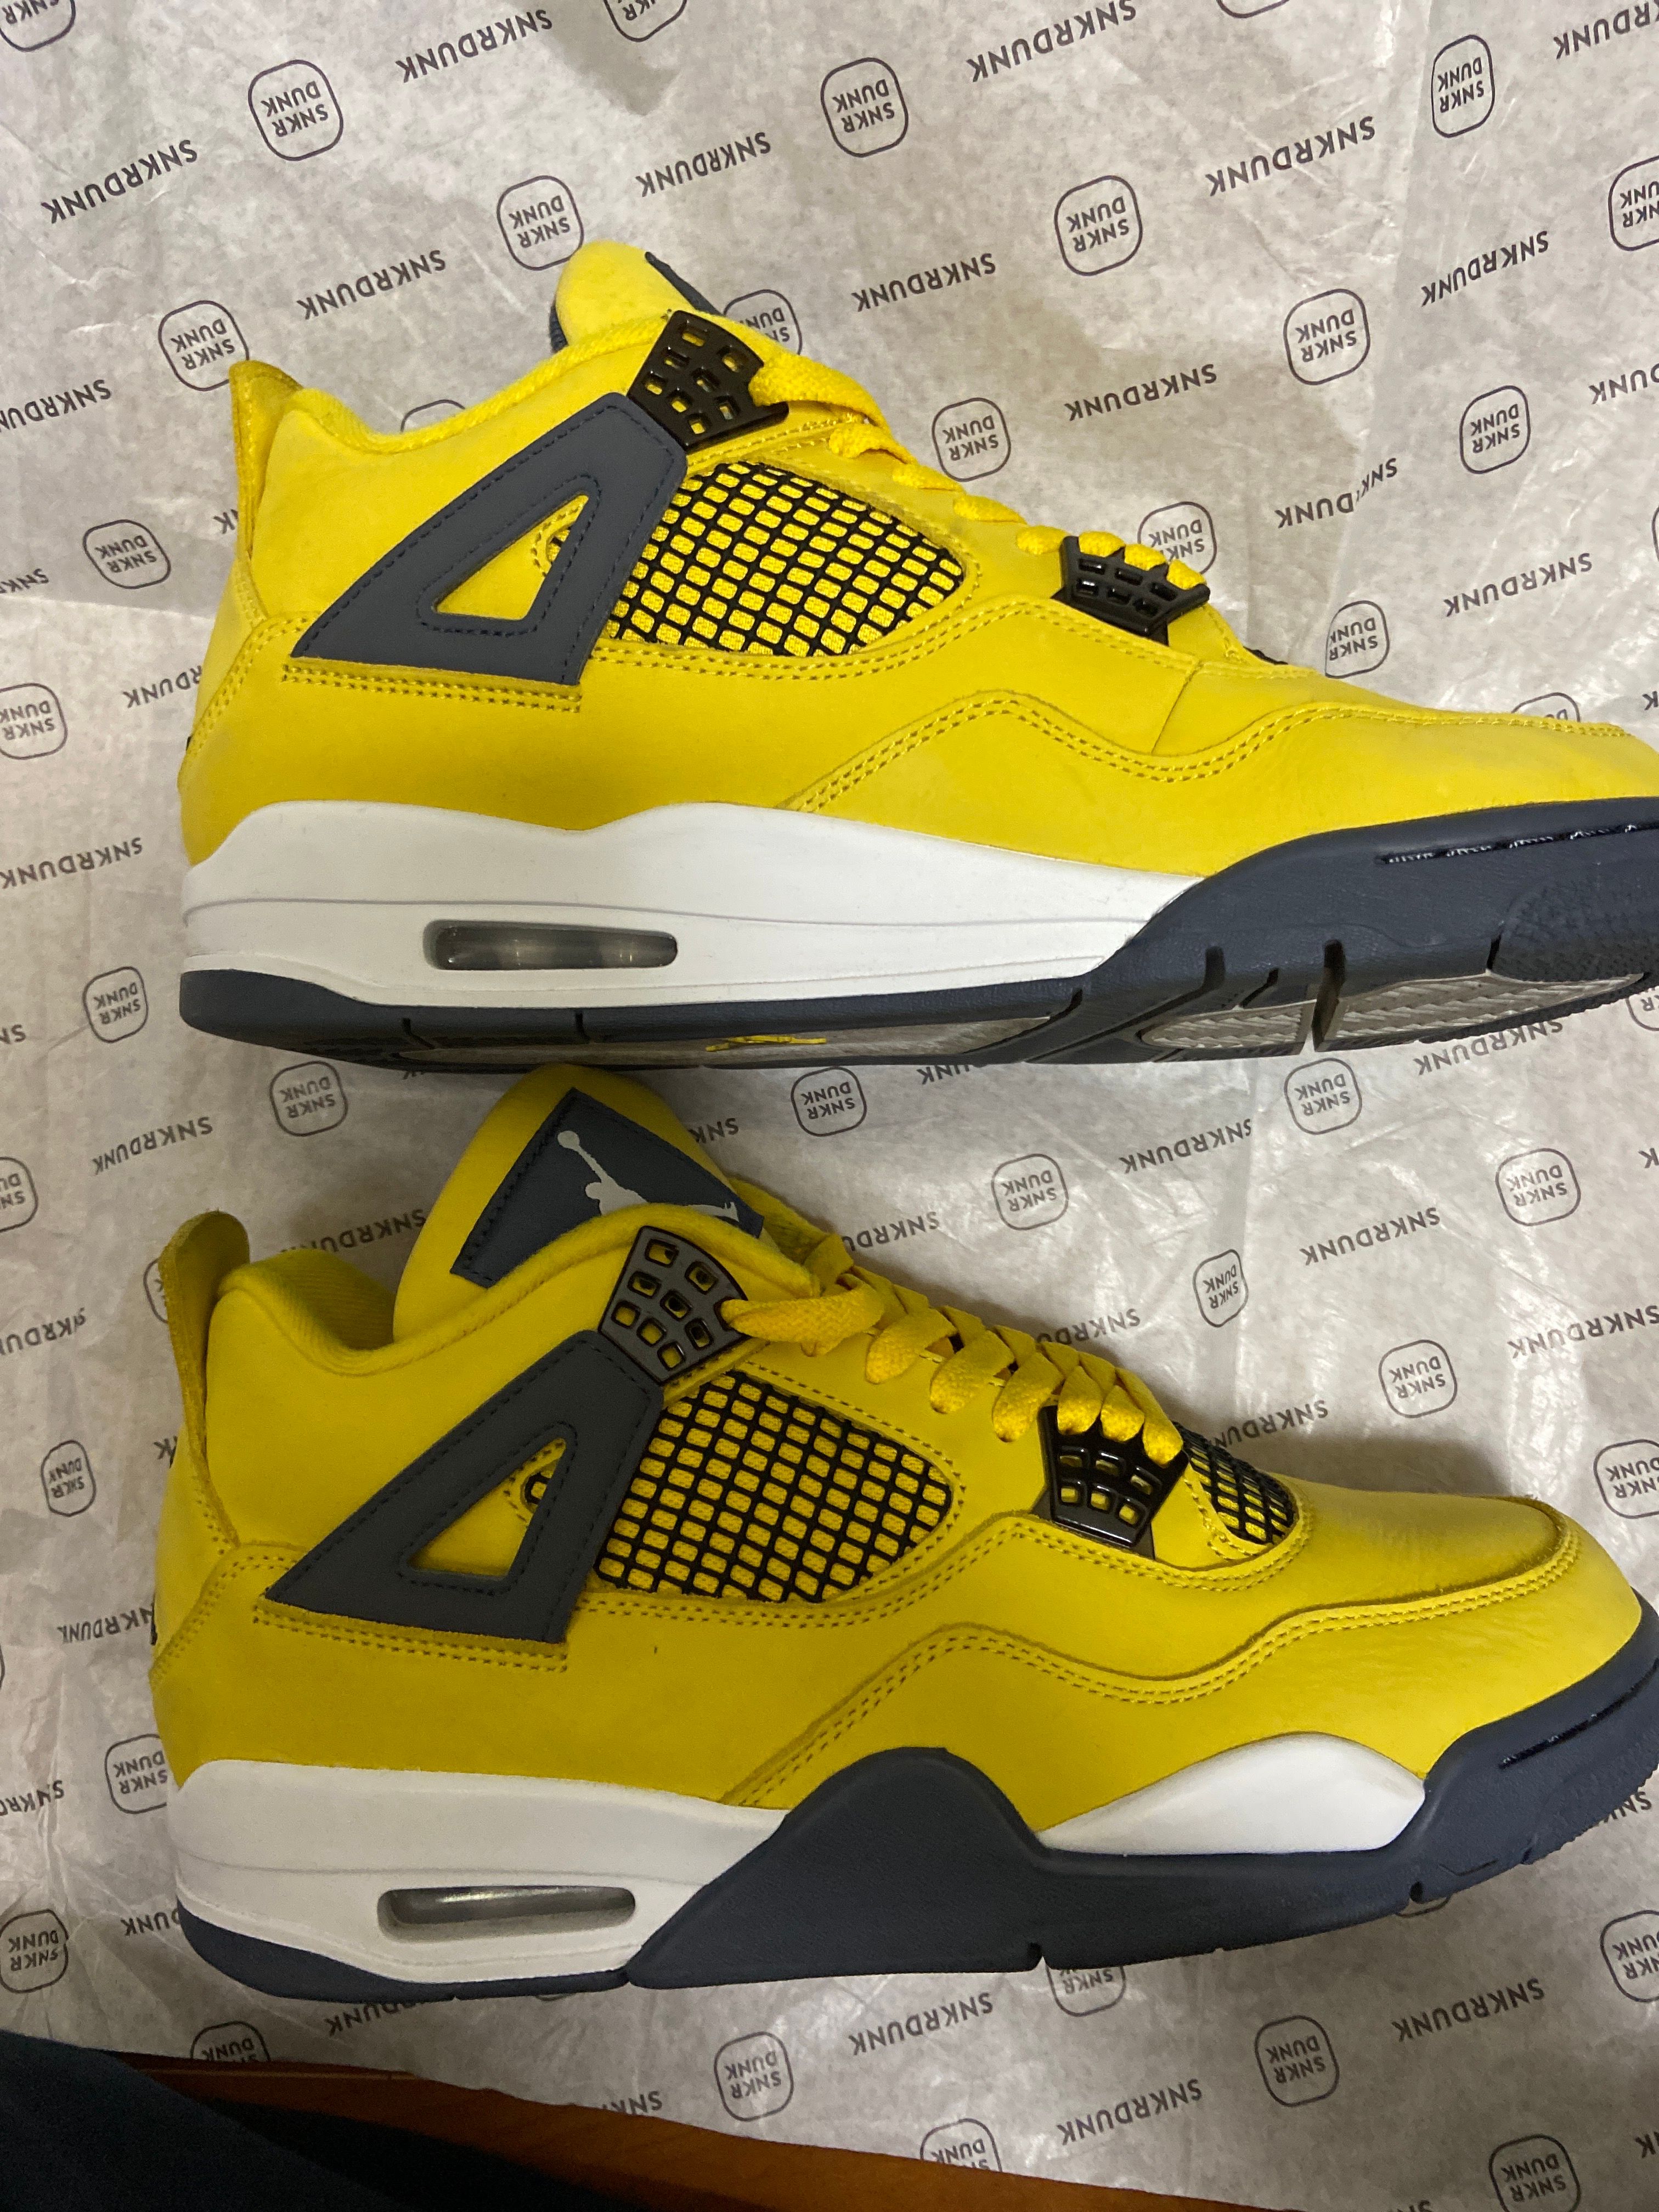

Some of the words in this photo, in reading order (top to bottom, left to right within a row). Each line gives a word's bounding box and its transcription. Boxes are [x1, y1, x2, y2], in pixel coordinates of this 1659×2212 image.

[396, 9, 552, 82] SNKRDUNK
[966, 0, 1136, 82] SNKRDUNK
[1438, 57, 1482, 92] DUNK
[261, 81, 320, 117] DUNK
[832, 80, 889, 112] DUNK
[1440, 81, 1483, 113] SNKR
[272, 104, 328, 137] SNKR
[842, 103, 894, 133] SNKR
[636, 132, 771, 196] SNKRDUNK
[1206, 116, 1375, 196] SNKRDUNK
[41, 140, 197, 223] SNKRDUNK
[1620, 180, 1659, 210] UNK
[509, 196, 564, 229] DUNK
[1066, 196, 1125, 232] DUNK
[1622, 203, 1659, 229] NKR
[517, 217, 570, 248] SNKR
[1073, 219, 1129, 252] SNKR
[851, 253, 995, 312] SNKRDUNK
[1421, 231, 1548, 307] SNKRDUNK
[297, 250, 445, 319] SNKRDUNK
[171, 319, 227, 352] DUNK
[1296, 309, 1356, 346] DUNK
[182, 339, 234, 369] SNKR
[1301, 331, 1356, 362] SNKR
[1064, 364, 1216, 421] SNKRDUNK
[943, 415, 995, 443] DUNK
[1471, 404, 1520, 438] DUNK
[949, 435, 998, 461] SNKR
[1473, 424, 1520, 453] SNKR
[95, 535, 148, 558] DUNK
[1149, 520, 1202, 548] DUNK
[107, 551, 156, 573] SNKR
[1444, 553, 1592, 617] SNKRDUNK
[1328, 636, 1379, 663] SNKR
[0, 699, 52, 726] DUNK
[3, 718, 54, 740] SNKR
[1, 837, 144, 890] SNKRDUNK
[94, 983, 138, 1009] DUNK
[99, 999, 140, 1024] SNKR
[1413, 1022, 1563, 1075] SNKRDUNK
[280, 1076, 331, 1102] DUNK
[801, 1082, 851, 1105] DUNK
[1295, 1074, 1346, 1100] DUNK
[286, 1094, 336, 1118] SNKR
[807, 1098, 855, 1119] SNKR
[1302, 1091, 1350, 1116] SNKR
[93, 1117, 213, 1175] SNKRDUNK
[1119, 1119, 1251, 1173] SNKRDUNK
[1001, 1170, 1053, 1195] DUNK
[1505, 1164, 1563, 1192] DUNK
[1008, 1188, 1056, 1211] SNKR
[1514, 1182, 1567, 1208] SNKR
[842, 1211, 940, 1251] SNKRDU
[1300, 1207, 1440, 1265] SNKRDUNK
[1203, 1265, 1237, 1293] DUNK
[1209, 1282, 1238, 1308] SNKR
[1389, 1356, 1441, 1383] DUNK
[1396, 1374, 1446, 1398] SNKR
[112, 1750, 166, 1779] DUNK
[119, 1769, 168, 1796] SNKR
[7, 1929, 59, 1952] DUNK
[1612, 1937, 1659, 1961] UNK
[9, 1950, 58, 1972] SNKR
[1623, 1954, 1659, 1980] NKR
[1063, 1968, 1114, 1995] SNKR
[849, 1993, 993, 2055] SNKRDUNK
[1392, 1978, 1544, 2042] SNKRDUNK
[1266, 2036, 1320, 2063] DUNK
[726, 2050, 778, 2078] DUNK
[1274, 2057, 1325, 2084] SNKR
[731, 2074, 782, 2100] SNKR
[1057, 2078, 1204, 2143] SNKRDUNK
[932, 2139, 986, 2164] DUNK
[1501, 2154, 1559, 2182] DUNK
[1510, 2175, 1566, 2202] SNKR
